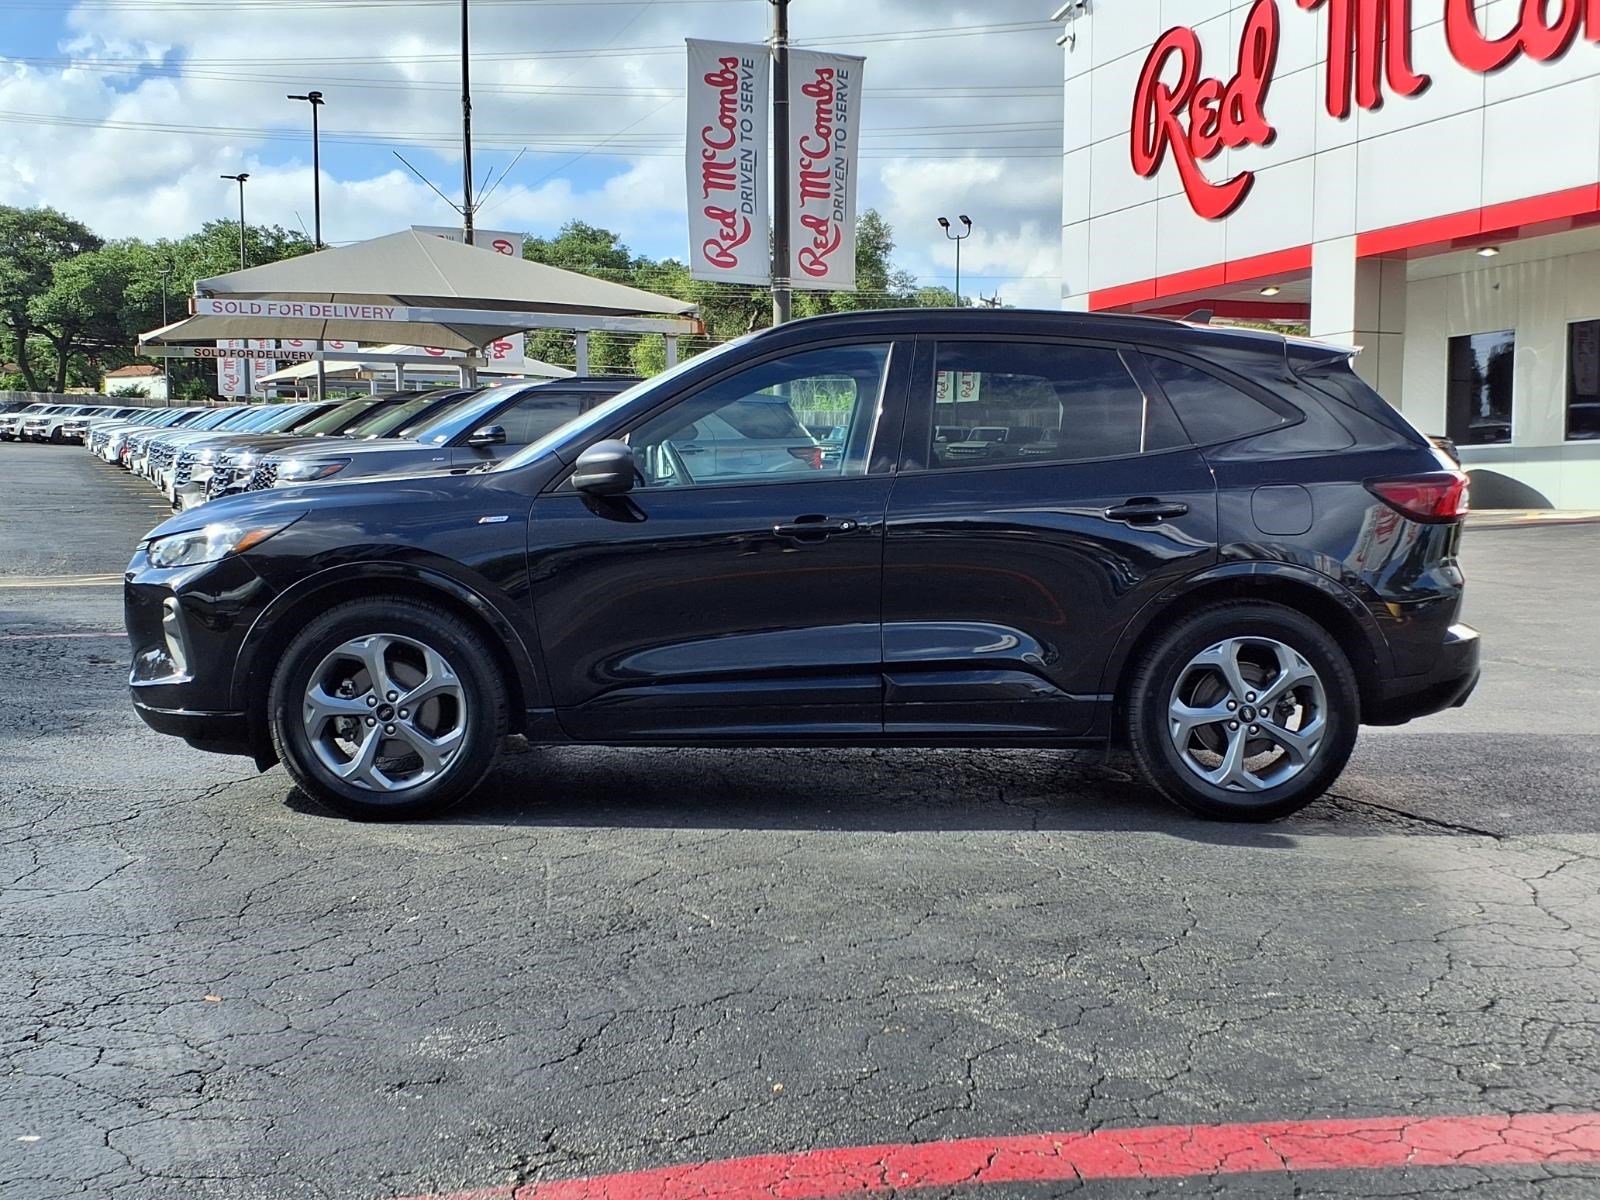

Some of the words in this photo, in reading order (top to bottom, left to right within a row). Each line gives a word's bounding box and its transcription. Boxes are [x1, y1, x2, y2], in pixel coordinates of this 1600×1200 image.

[741, 57, 754, 114] SERVE
[835, 68, 849, 124] SERVE
[1131, 0, 1279, 219] Red
[702, 56, 739, 200] McCombs
[740, 118, 754, 143] TO
[799, 67, 834, 209] McCombs
[834, 128, 847, 153] TO
[740, 149, 754, 215] DRIVEN
[832, 156, 845, 223] DRIVEN
[702, 205, 751, 269] Red
[799, 213, 842, 277] Red
[212, 301, 262, 314] SOLD
[268, 303, 304, 316] FOR
[309, 304, 395, 319] DELIVERY
[194, 348, 227, 357] SOLD
[230, 349, 254, 358] FOR
[257, 350, 314, 360] DELIVERY
[223, 373, 240, 392] Red
